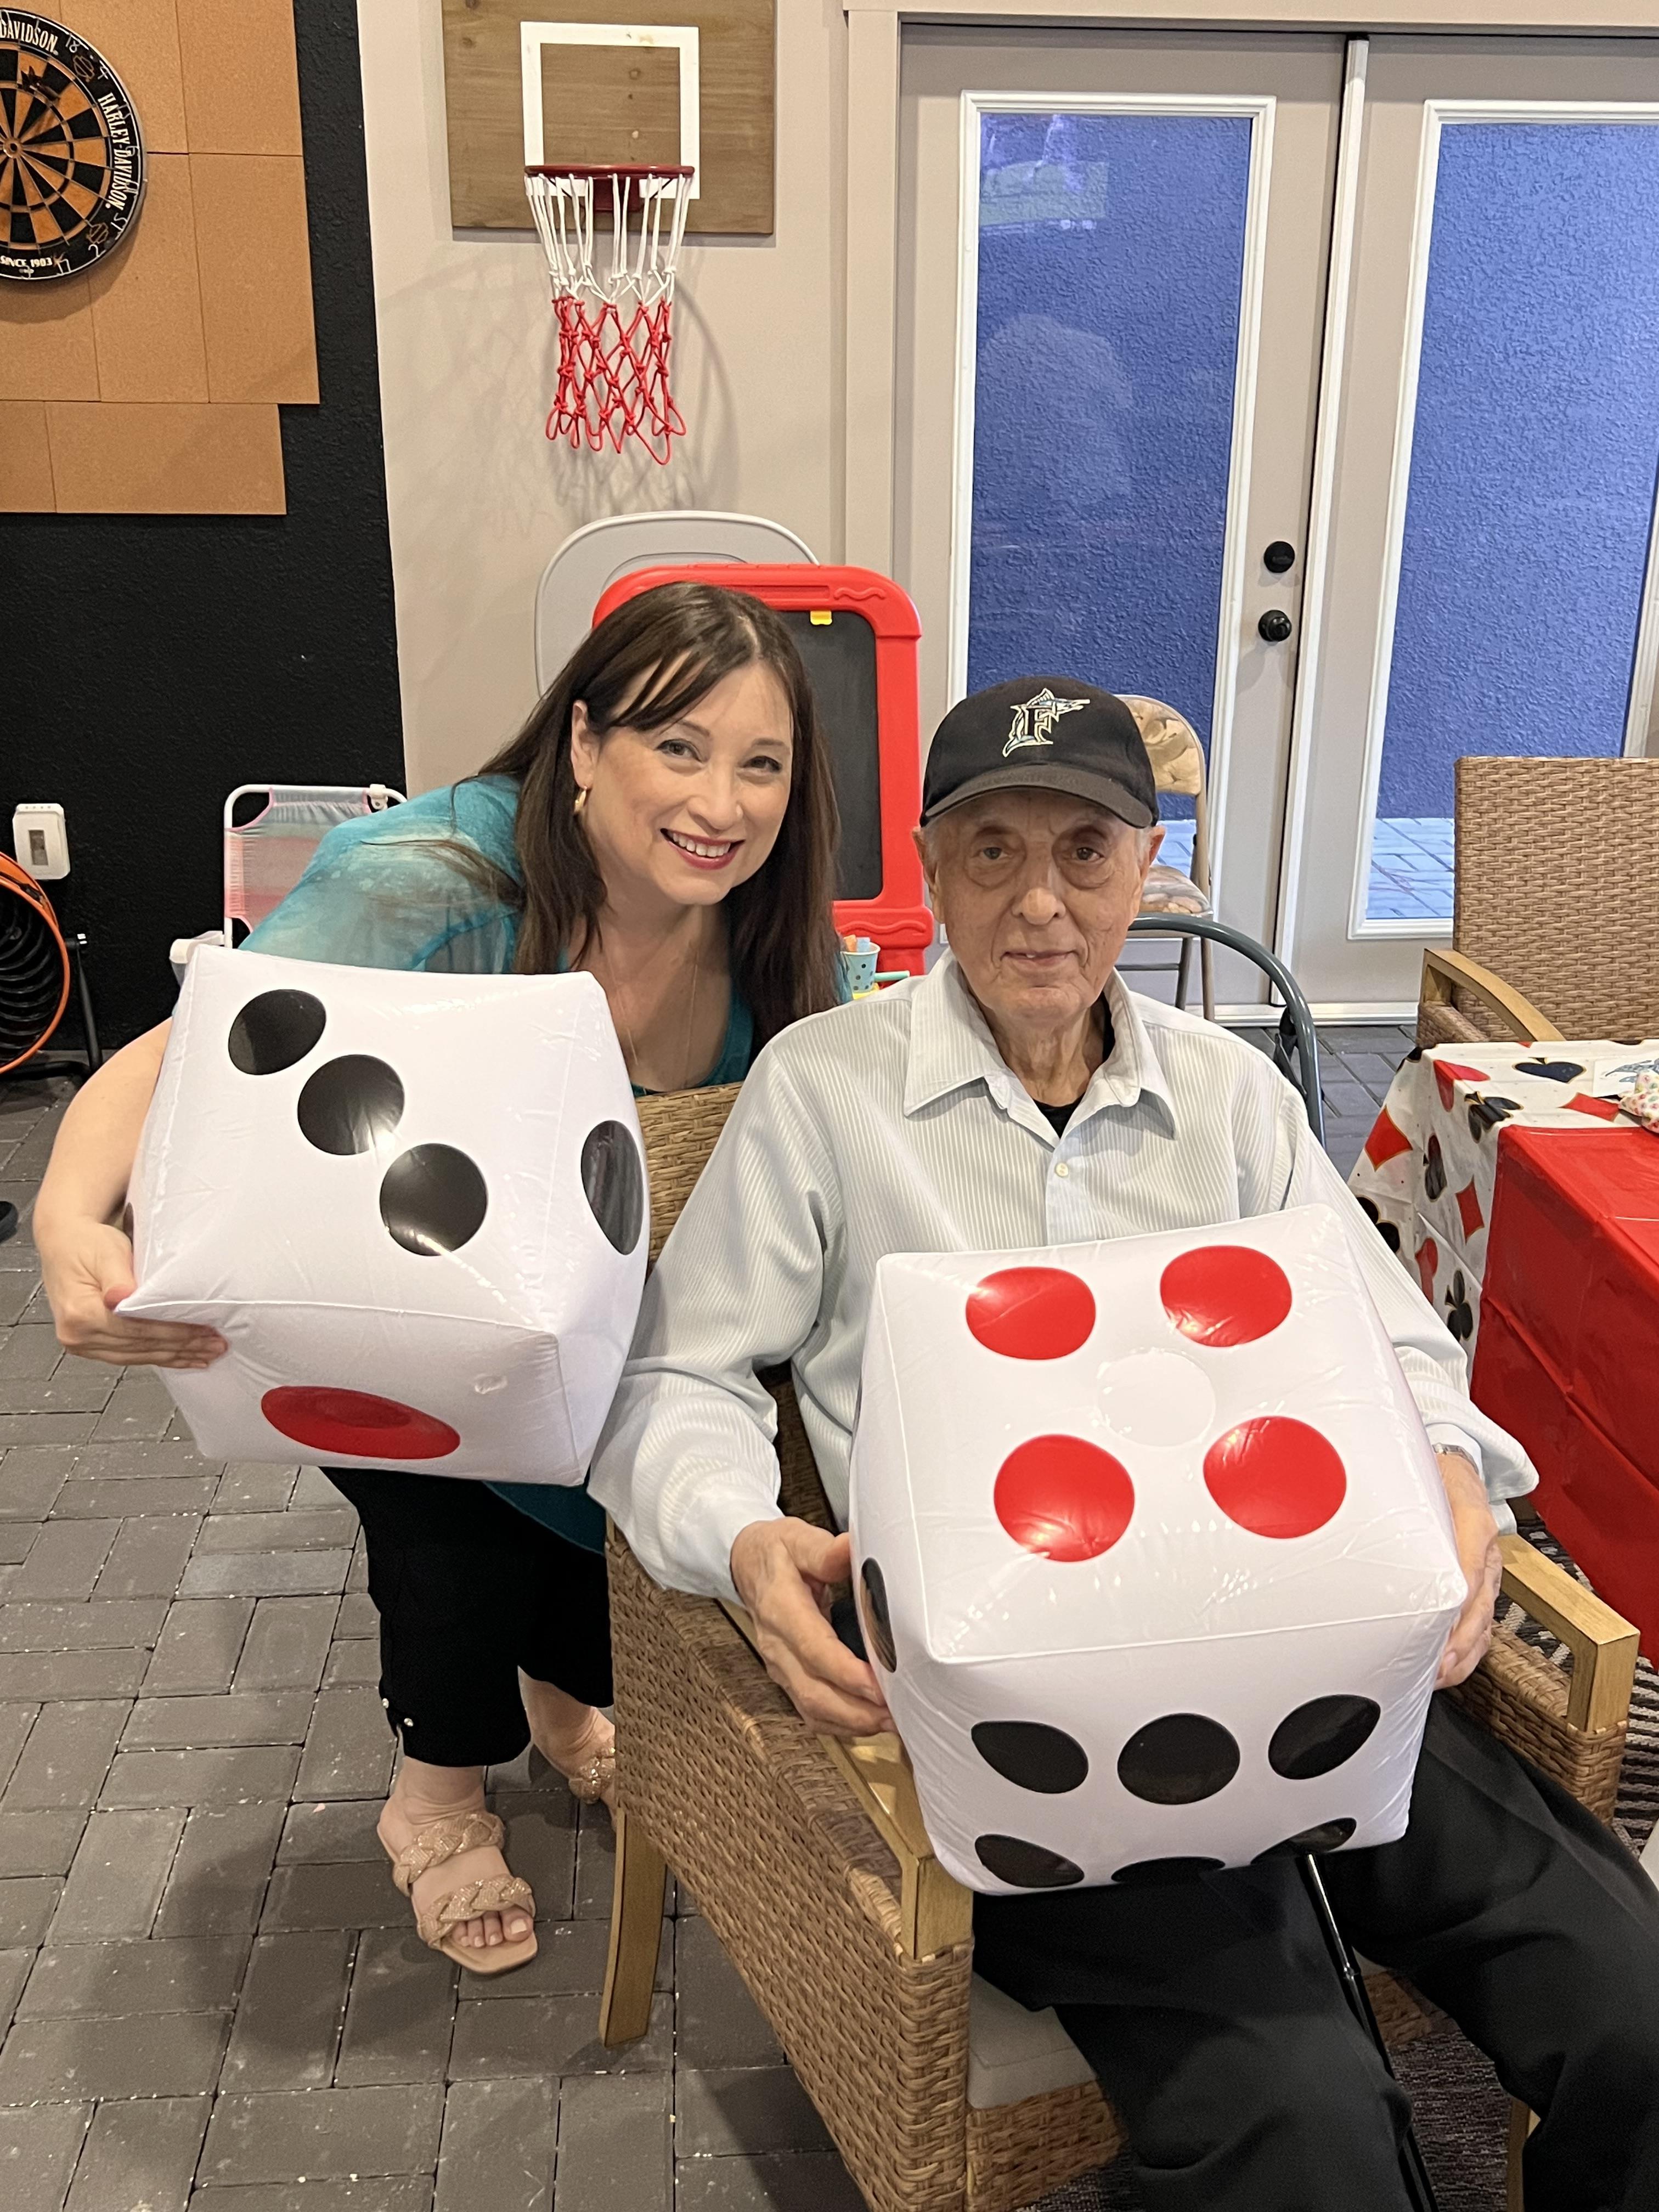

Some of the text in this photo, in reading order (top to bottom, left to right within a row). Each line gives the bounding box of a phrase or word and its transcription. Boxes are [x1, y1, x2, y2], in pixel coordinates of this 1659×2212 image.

[65, 35, 81, 53] 18
[98, 61, 110, 80] 4
[110, 212, 128, 231] 15
[30, 257, 53, 268] 1903
